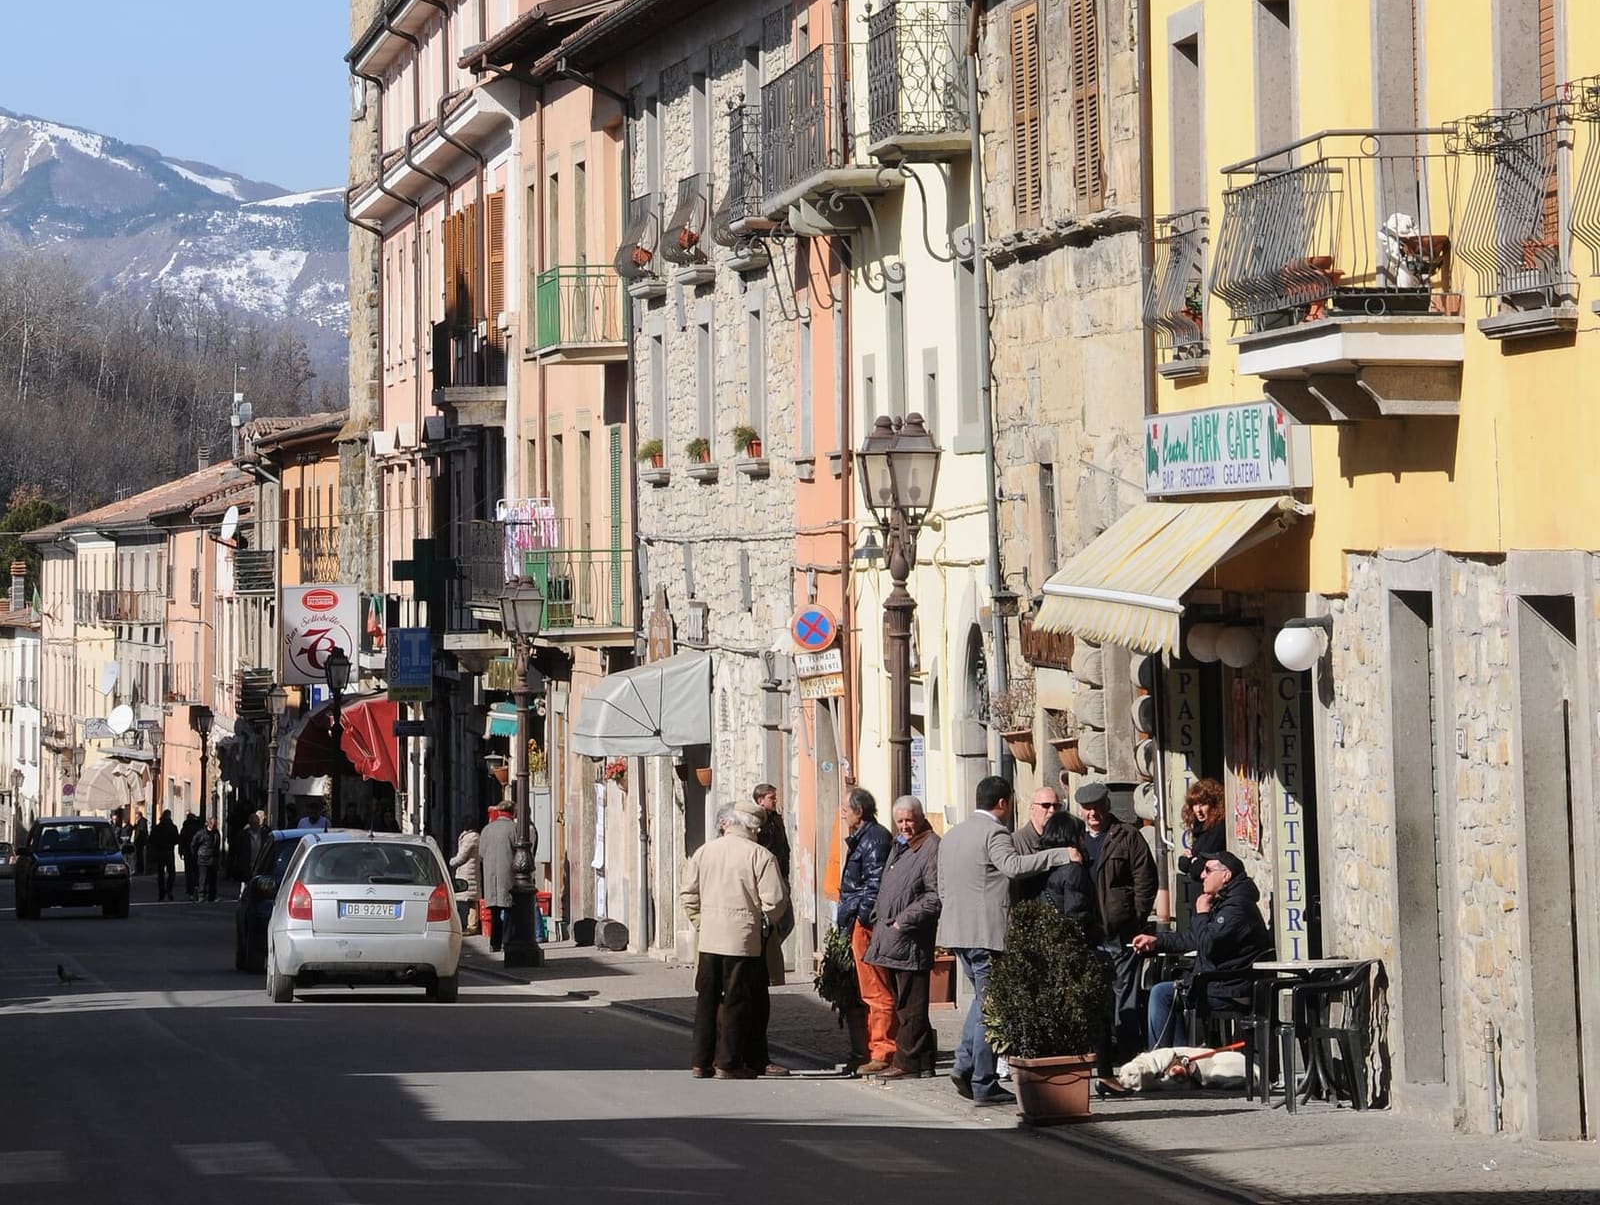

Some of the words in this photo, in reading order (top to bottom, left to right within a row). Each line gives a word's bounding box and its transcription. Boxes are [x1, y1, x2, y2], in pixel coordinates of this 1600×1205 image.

[1162, 423, 1189, 467] Central
[1192, 411, 1221, 464] PARK
[1162, 470, 1174, 490] BAR
[1180, 466, 1216, 489] PASTICCERIA
[1223, 462, 1261, 485] GELATERIA
[1278, 676, 1304, 961] CAFFETTERI
[347, 904, 360, 915] DB
